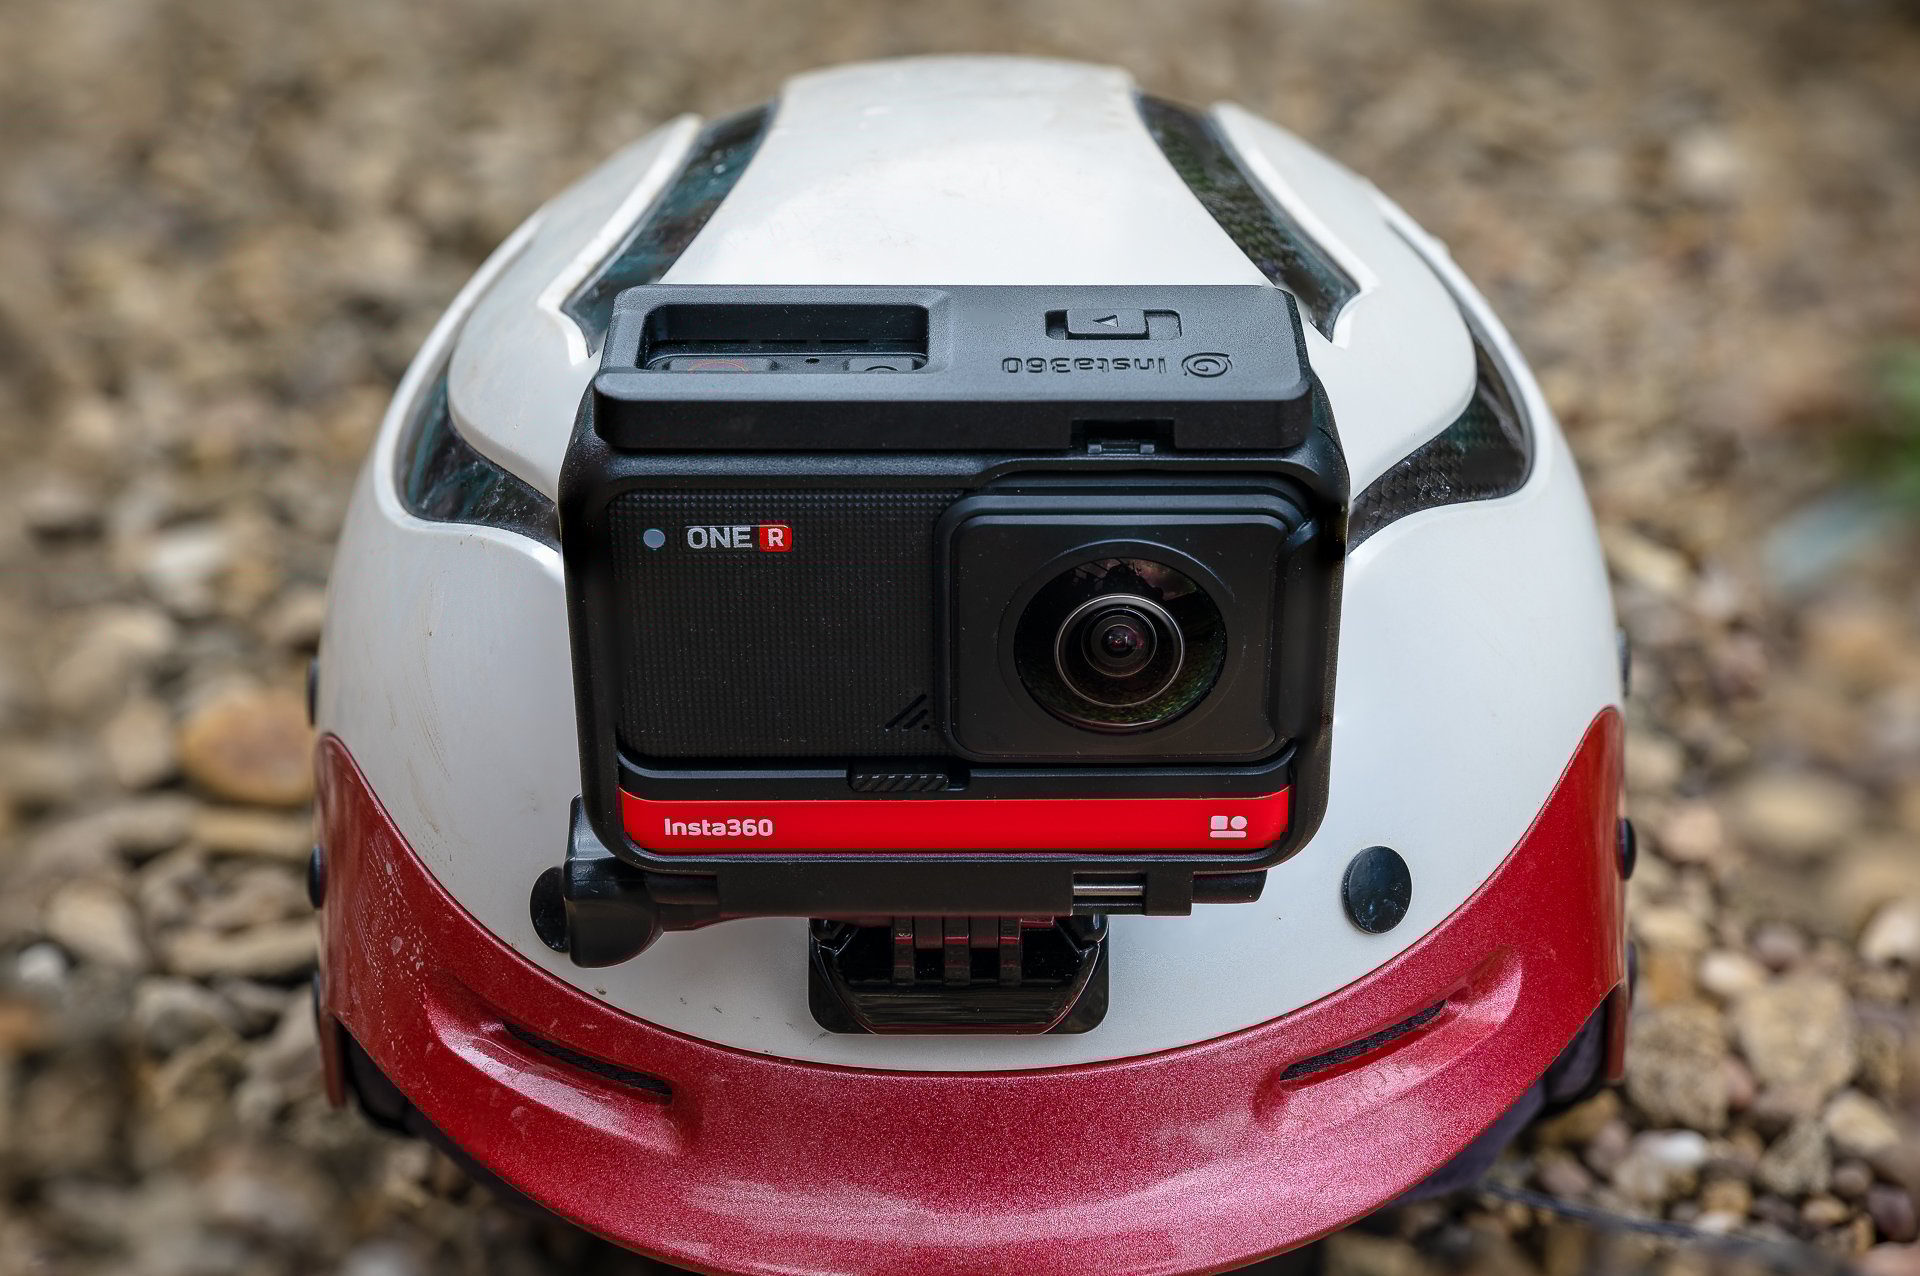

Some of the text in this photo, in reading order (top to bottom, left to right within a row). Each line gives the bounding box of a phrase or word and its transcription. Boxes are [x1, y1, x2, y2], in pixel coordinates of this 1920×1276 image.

[1001, 356, 1167, 374] Insta360
[686, 527, 785, 549] ONE R
[664, 818, 773, 836] Insta360
